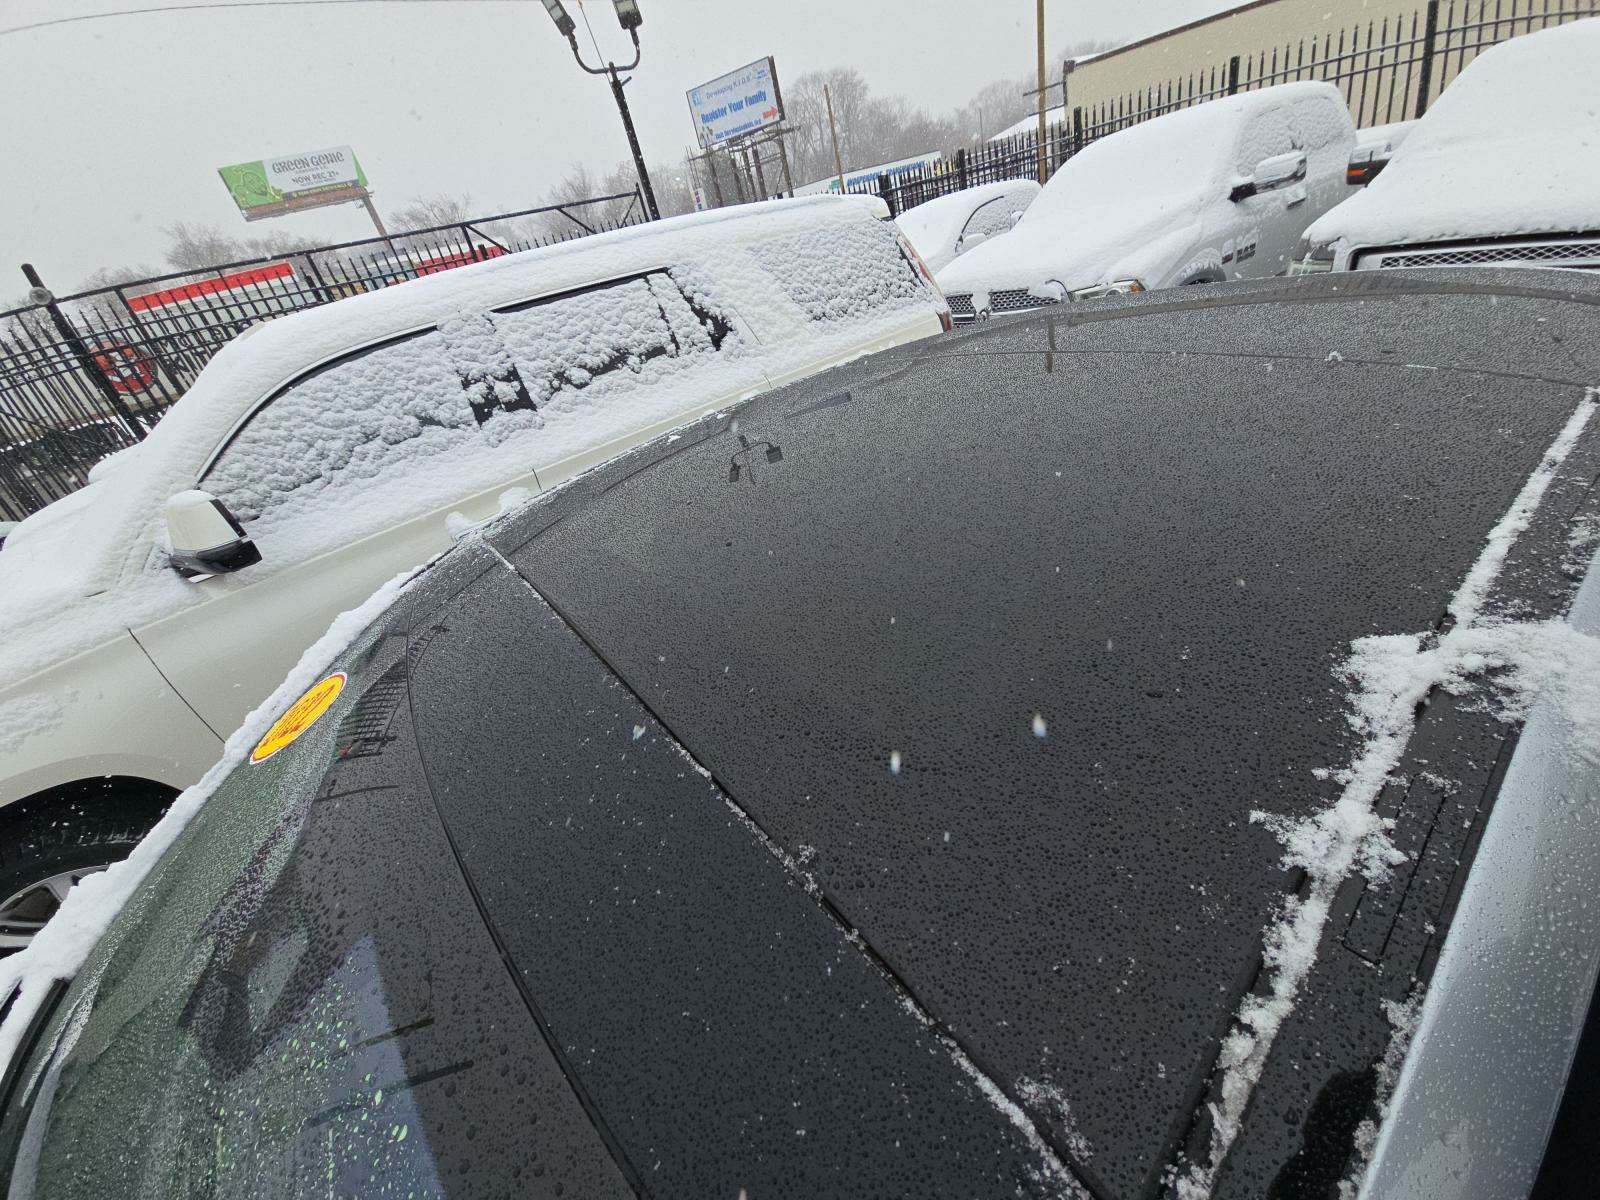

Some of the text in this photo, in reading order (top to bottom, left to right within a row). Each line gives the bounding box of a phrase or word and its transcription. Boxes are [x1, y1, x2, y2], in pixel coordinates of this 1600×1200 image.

[701, 90, 766, 124] Register Your Family
